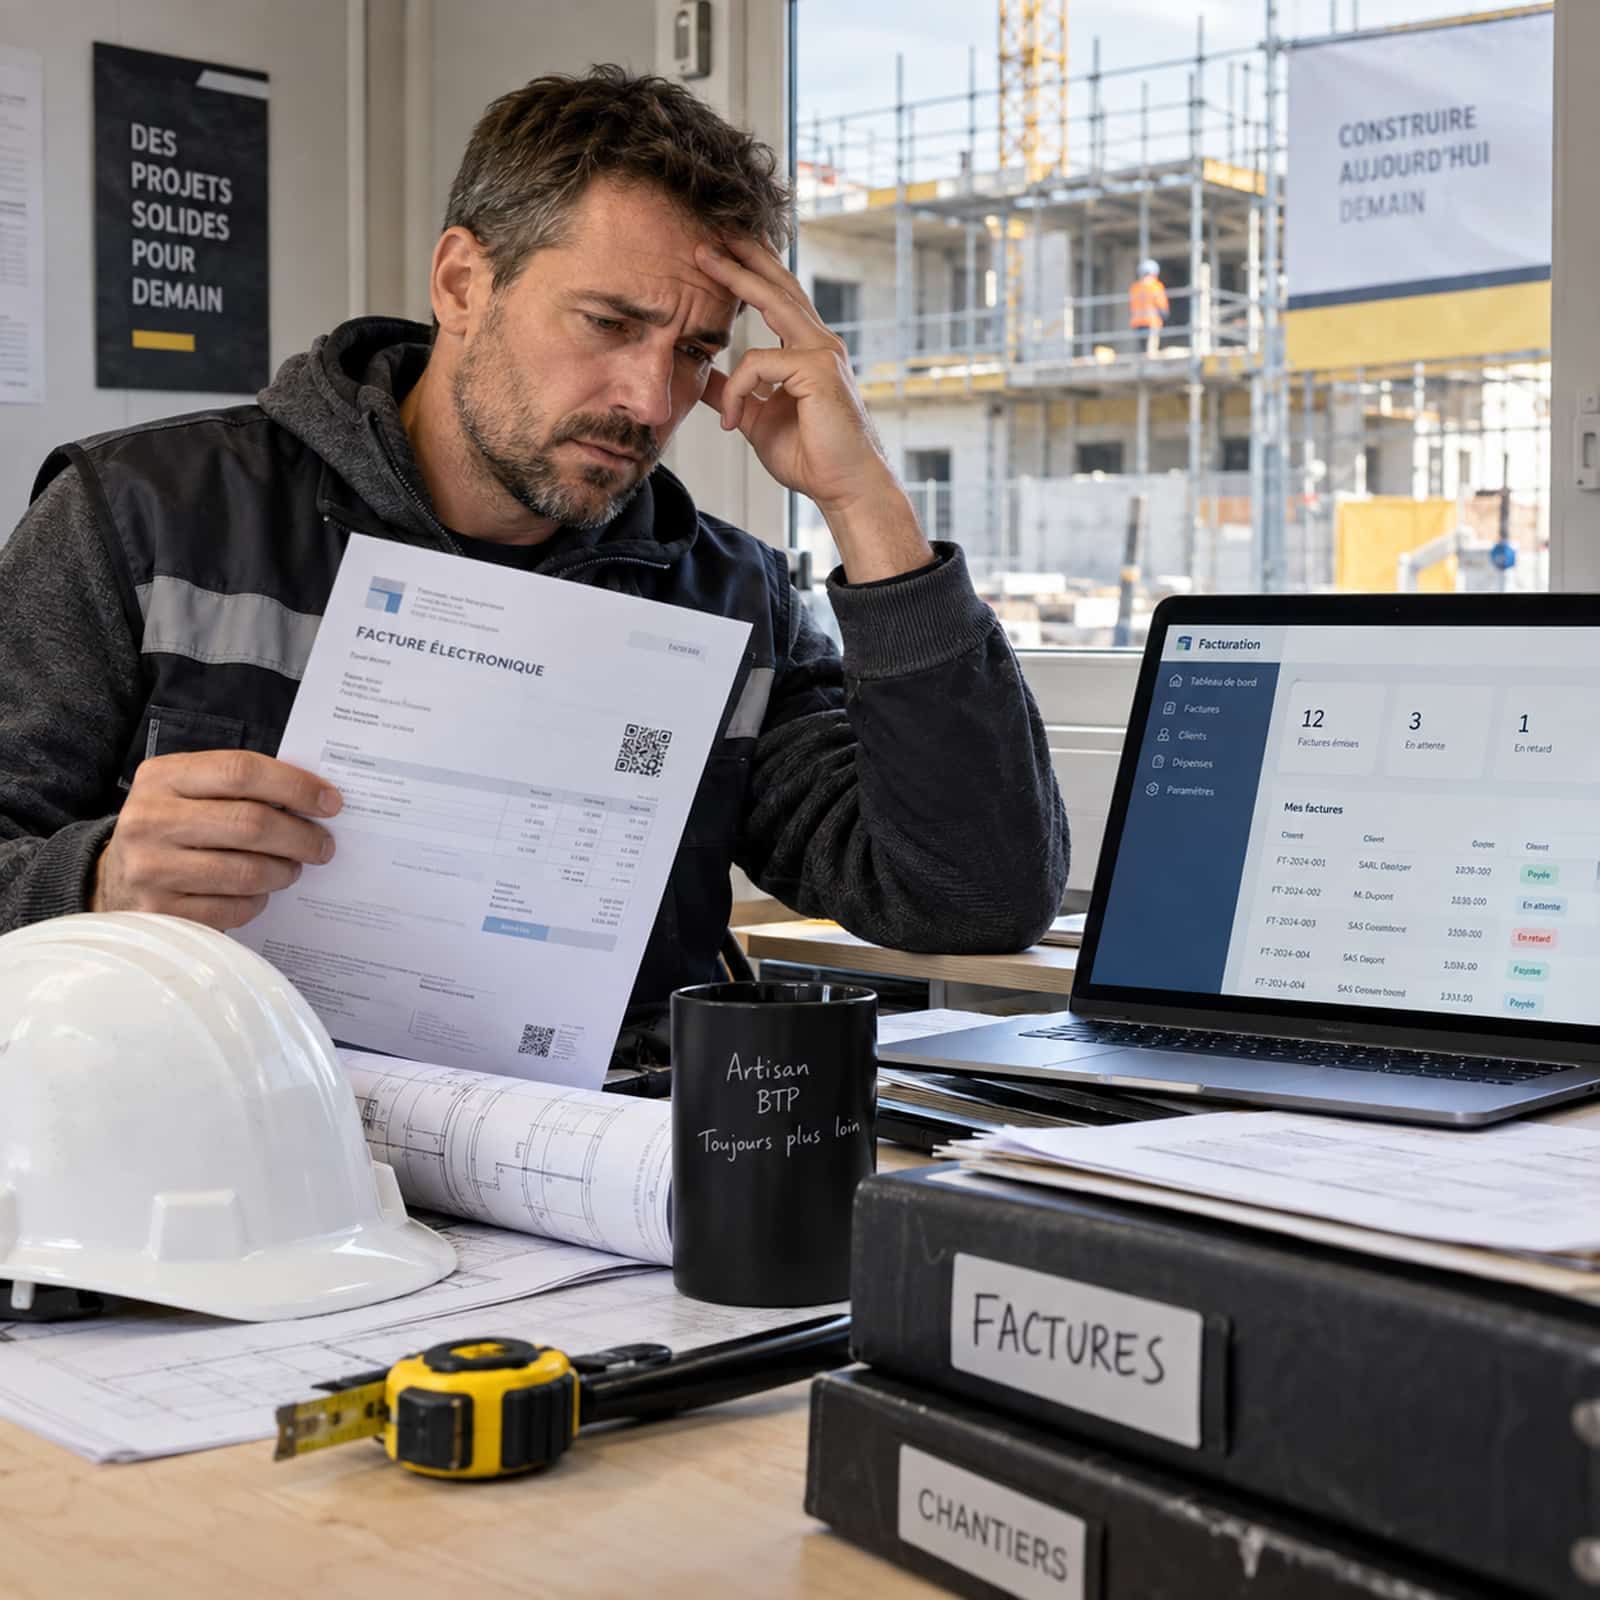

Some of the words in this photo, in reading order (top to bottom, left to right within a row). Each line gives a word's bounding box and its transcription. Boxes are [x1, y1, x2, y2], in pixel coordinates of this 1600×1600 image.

[131, 123, 177, 157] DES
[1339, 106, 1476, 149] CONSTRUIRE
[1339, 140, 1490, 184] AUJOURD'HUI
[131, 161, 232, 204] PROJETS
[1340, 189, 1425, 225] DEMAIN
[132, 201, 229, 241] SOLIDES
[132, 239, 195, 272] POUR
[132, 278, 223, 312] DEMAIN
[356, 626, 427, 652] FACTURE
[430, 640, 544, 677] ÉLECTRONIQUE
[1198, 638, 1261, 650] Facturation
[1190, 676, 1222, 687] Tableau
[1224, 677, 1235, 687] de
[1236, 677, 1258, 688] bord
[1184, 703, 1220, 715] Factures
[1302, 709, 1325, 728] 12
[1408, 711, 1422, 730] 3
[1178, 730, 1207, 741] Clients
[1518, 713, 1529, 733] 1
[1297, 737, 1330, 748] Factures
[1405, 740, 1416, 750] En
[1417, 740, 1446, 751] attente
[1514, 744, 1526, 753] En
[1527, 744, 1553, 753] retard
[1284, 803, 1303, 813] Mes
[1305, 803, 1344, 815] factures
[1276, 856, 1327, 867] FT-2024-001
[1271, 885, 1322, 897] FT-2024-002
[1365, 890, 1394, 902] Dupont
[1522, 901, 1533, 910] En
[1534, 902, 1561, 912] attente
[1265, 916, 1316, 928] FT-2024-003
[1347, 921, 1364, 931] SAS
[1517, 933, 1528, 942] En
[1528, 934, 1551, 943] retard
[1260, 947, 1311, 959] FT-2024-004
[1342, 953, 1358, 962] SAS
[1337, 983, 1352, 993] SAS
[726, 1052, 810, 1081] Artisan
[757, 1087, 800, 1114] BTP
[697, 1128, 773, 1162] Toujours
[786, 1125, 821, 1157] plus
[835, 1115, 860, 1137] loin
[972, 1292, 1166, 1386] FACTURES
[917, 1488, 1069, 1582] CHANTIERS
